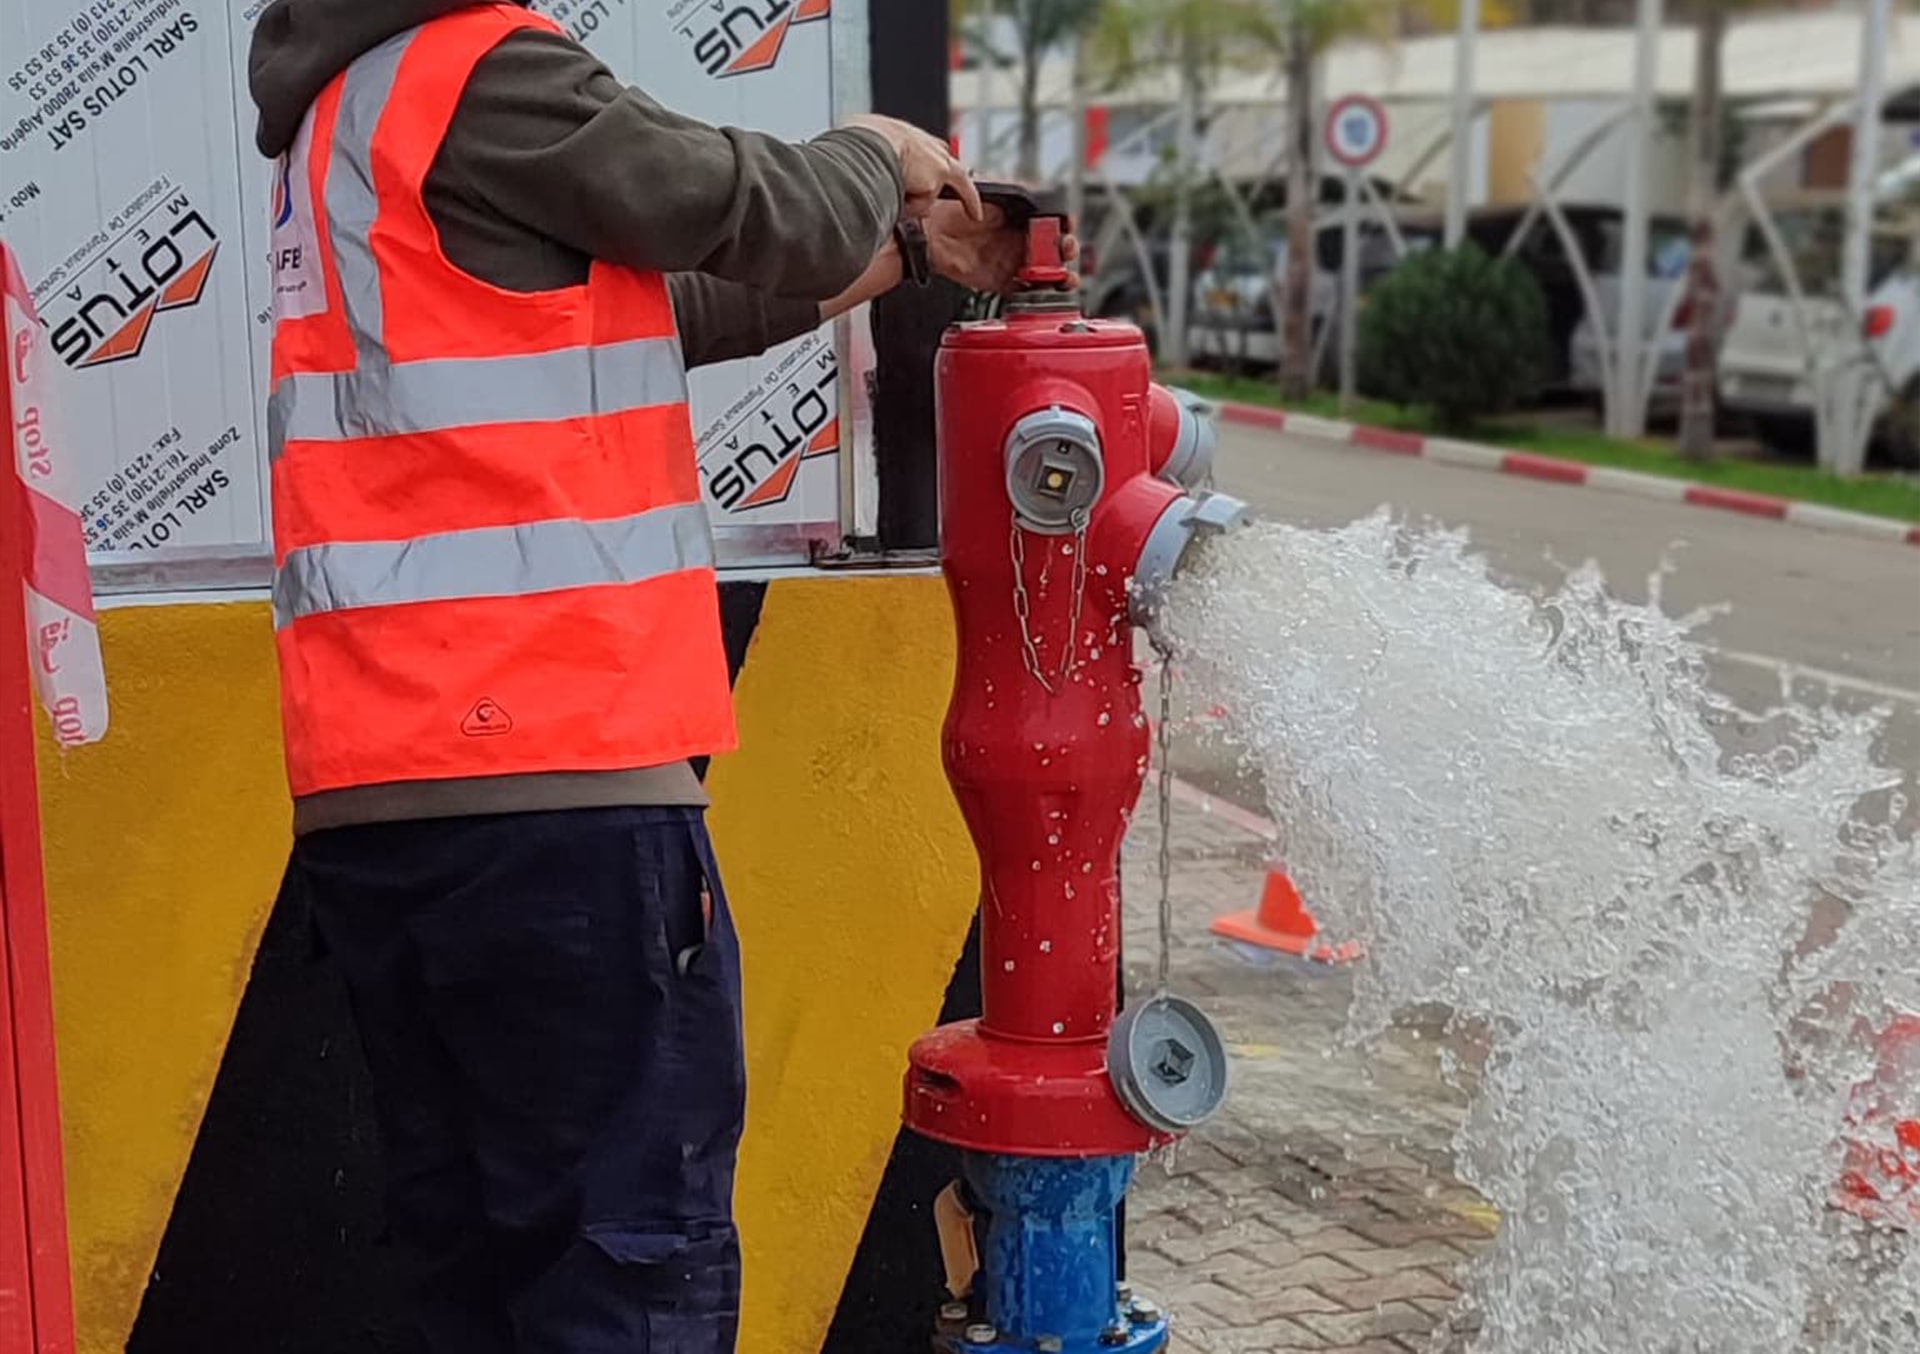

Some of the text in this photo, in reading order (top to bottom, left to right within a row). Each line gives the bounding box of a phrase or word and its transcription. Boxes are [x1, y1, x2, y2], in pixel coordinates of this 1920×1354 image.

[70, 11, 93, 36] (0)
[56, 29, 76, 50] 35
[693, 0, 791, 75] TUS
[39, 42, 60, 64] 36
[76, 39, 96, 61] 35
[24, 56, 44, 77] 53
[60, 53, 80, 74] 36
[7, 70, 28, 92] 35
[44, 67, 64, 88] 53
[47, 12, 199, 151] SARL LOTUS SAT
[28, 81, 48, 101] 53
[10, 181, 42, 209] Mob
[107, 215, 126, 232] De
[50, 209, 217, 367] LOTUS
[151, 426, 183, 453] Fax:
[207, 426, 242, 456] Zone
[124, 452, 154, 481] +213
[105, 473, 128, 495] (0)
[146, 452, 213, 512] Industrielle
[92, 490, 112, 510] 35
[111, 498, 131, 518] 35
[128, 469, 230, 551] SARL LOT
[95, 512, 115, 532] 36
